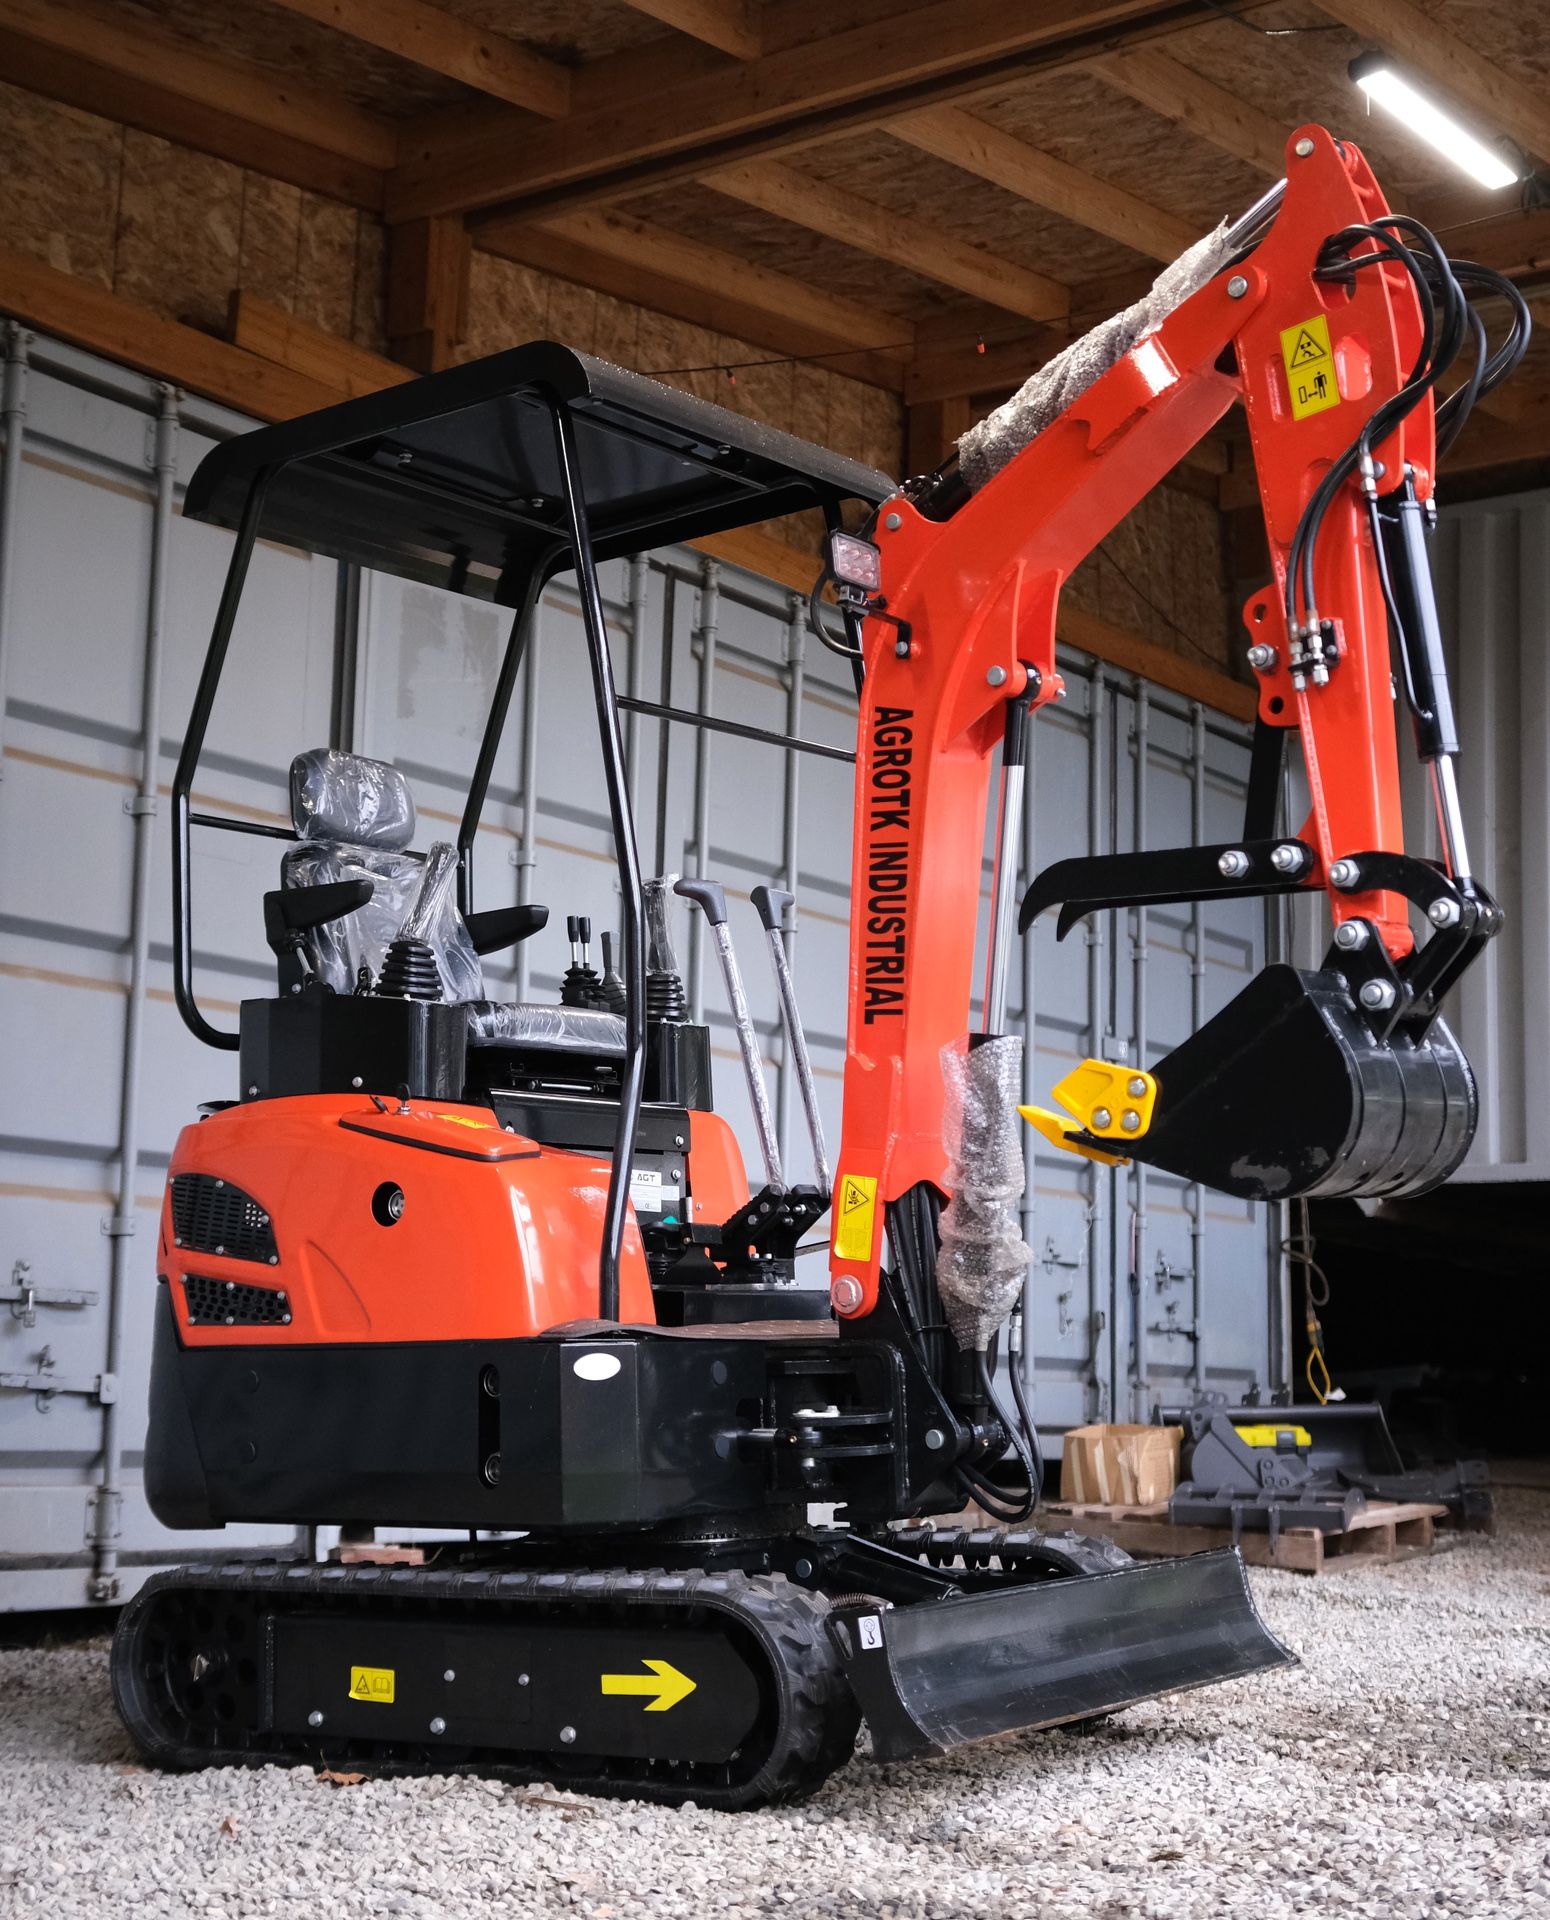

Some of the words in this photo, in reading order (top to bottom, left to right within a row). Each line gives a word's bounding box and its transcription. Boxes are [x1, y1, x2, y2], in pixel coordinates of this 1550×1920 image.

[869, 705, 914, 832] AGROTK
[864, 841, 909, 1025] INDUSTRIAL
[637, 1173, 656, 1182] AGT
